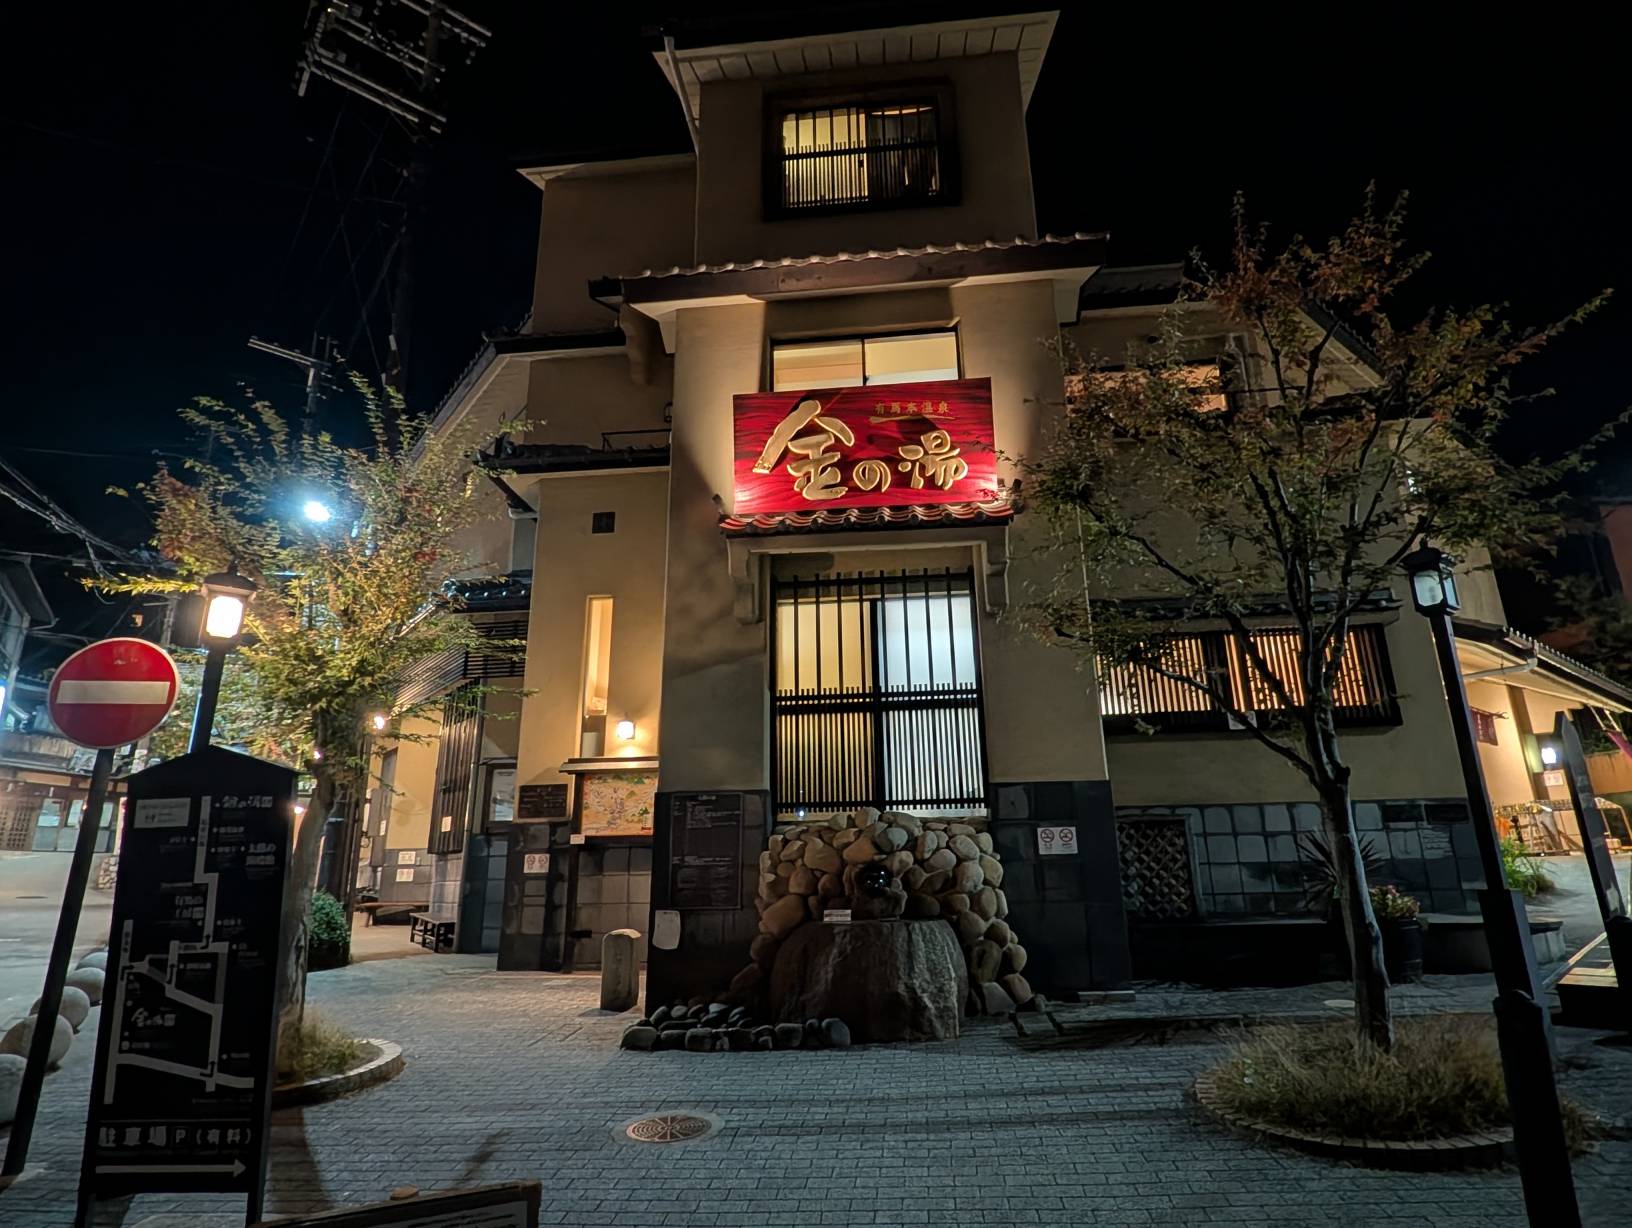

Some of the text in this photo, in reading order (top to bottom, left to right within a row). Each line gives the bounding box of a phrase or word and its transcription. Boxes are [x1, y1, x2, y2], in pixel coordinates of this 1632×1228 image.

[874, 399, 949, 415] 有馬本温泉
[752, 399, 968, 500] 金の湯
